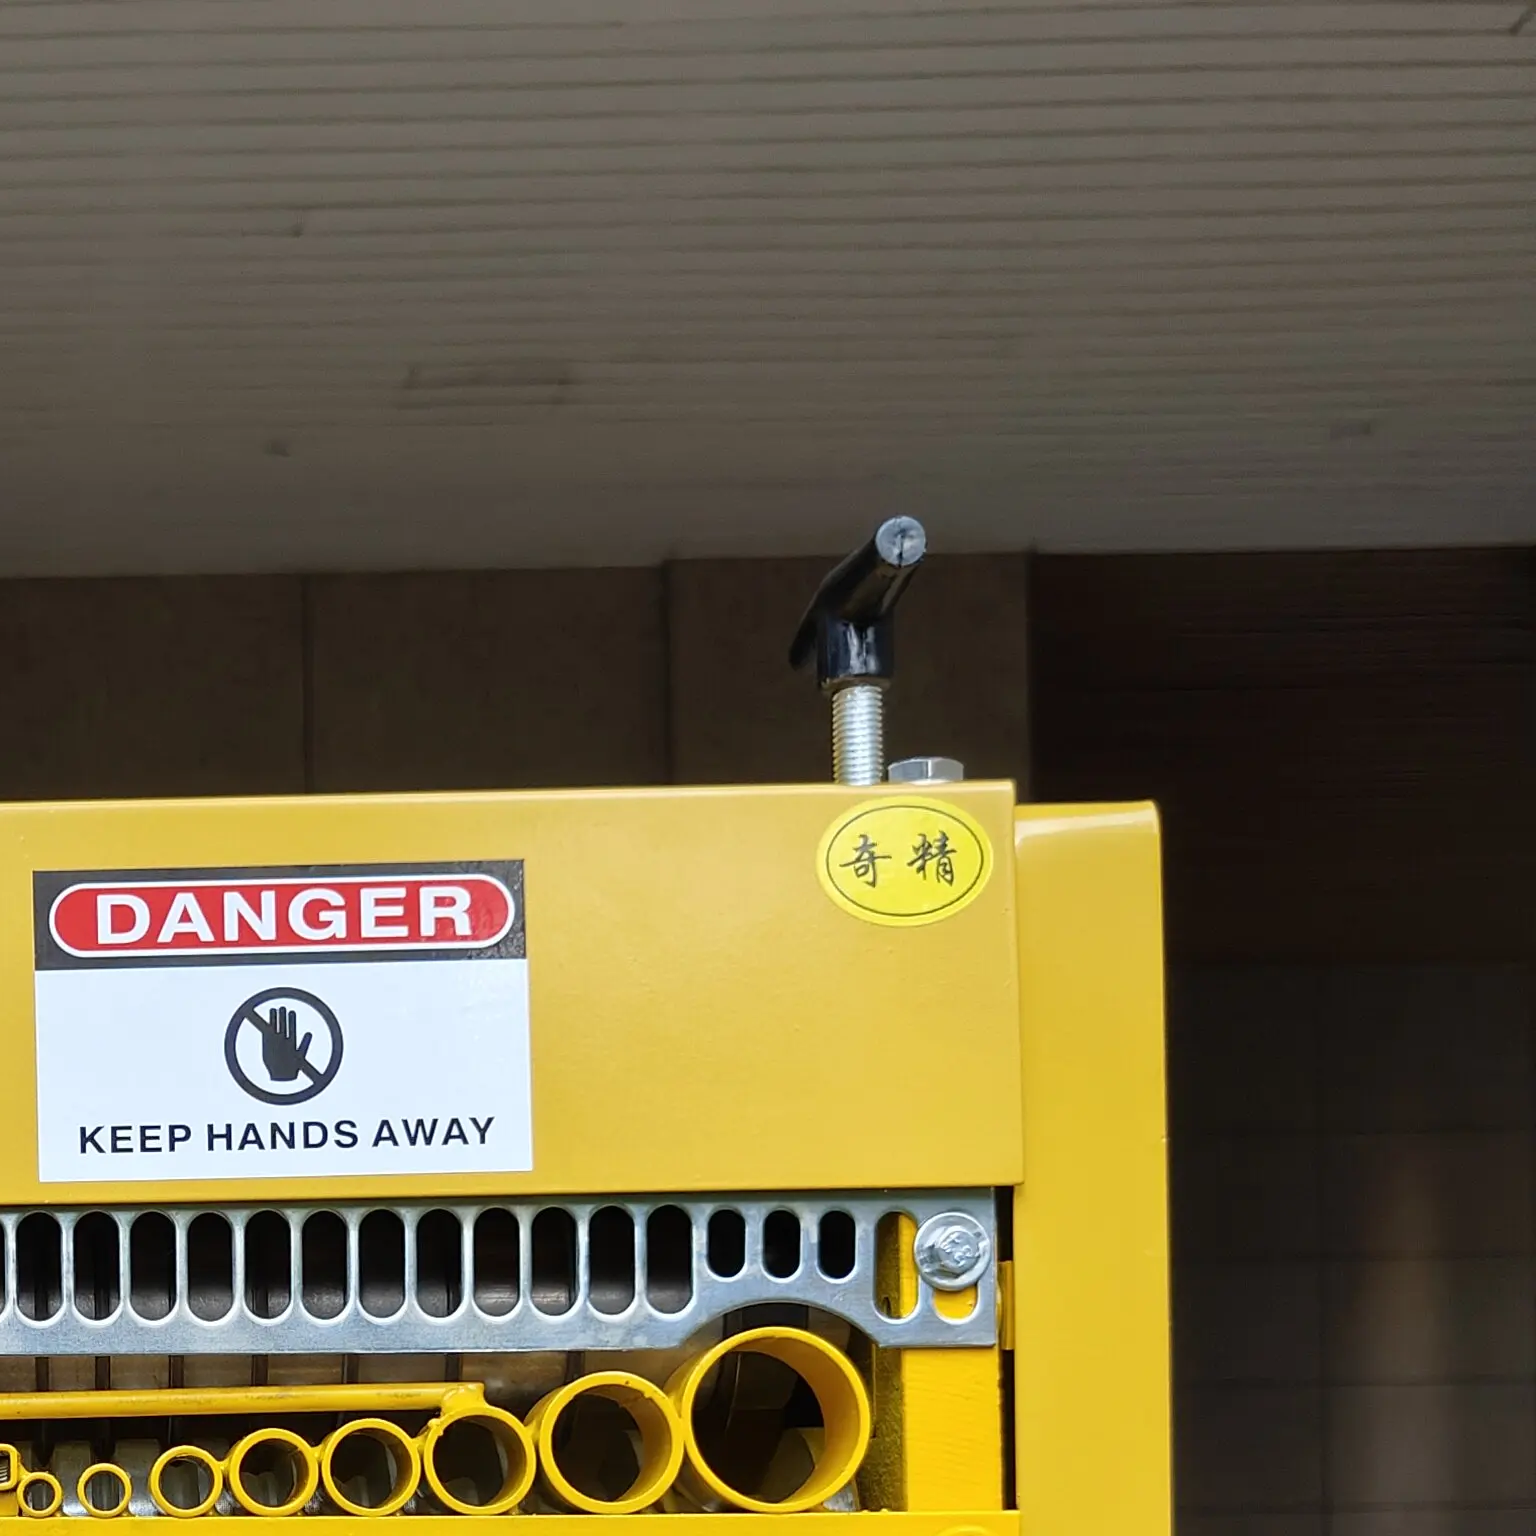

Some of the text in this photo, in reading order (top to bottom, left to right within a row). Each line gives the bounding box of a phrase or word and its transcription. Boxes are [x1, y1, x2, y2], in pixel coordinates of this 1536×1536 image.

[839, 830, 957, 888] 奇精
[95, 885, 473, 945] DANGER
[79, 1116, 495, 1155] KEEP HANDS AWAY
